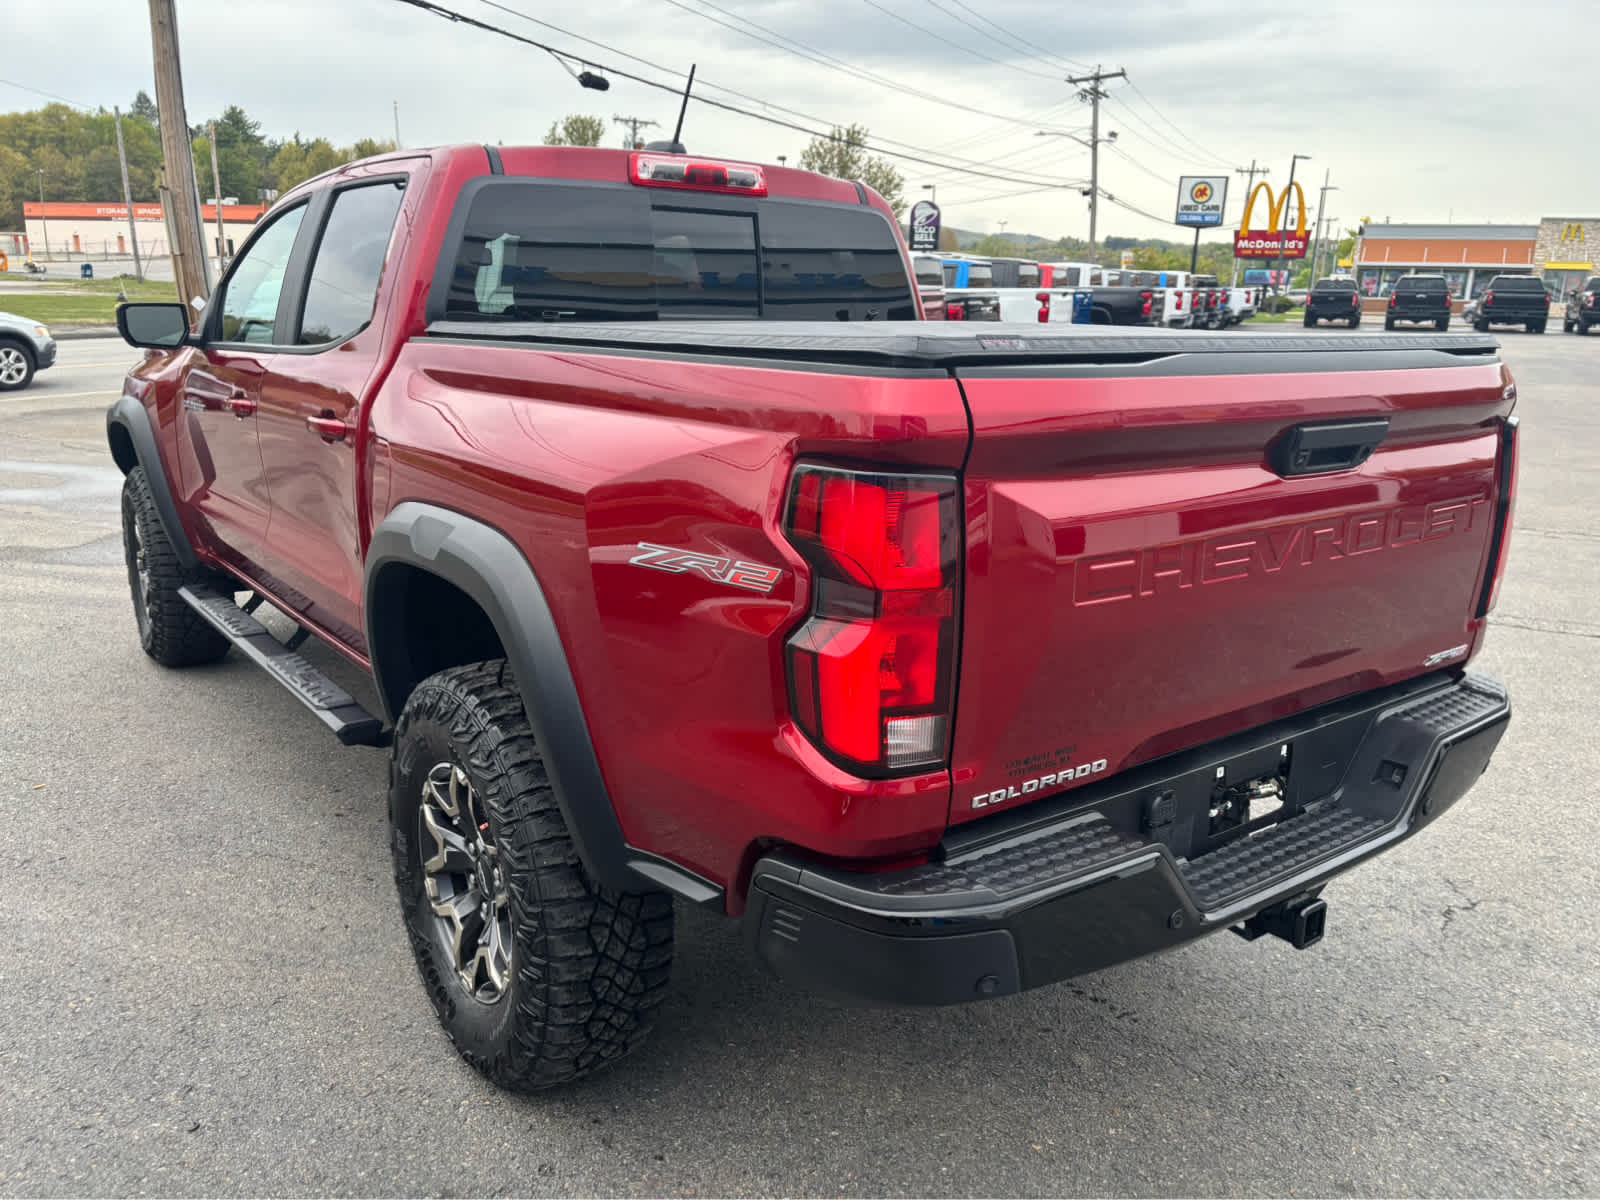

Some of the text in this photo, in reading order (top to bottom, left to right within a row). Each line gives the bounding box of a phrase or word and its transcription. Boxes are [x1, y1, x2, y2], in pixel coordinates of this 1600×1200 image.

[1180, 204, 1220, 212] USED CARS
[914, 226, 936, 234] TACO
[914, 233, 936, 241] BELL
[1073, 493, 1487, 607] CHEVROLET
[629, 541, 784, 594] ZR2
[971, 758, 1108, 809] COLORADO
